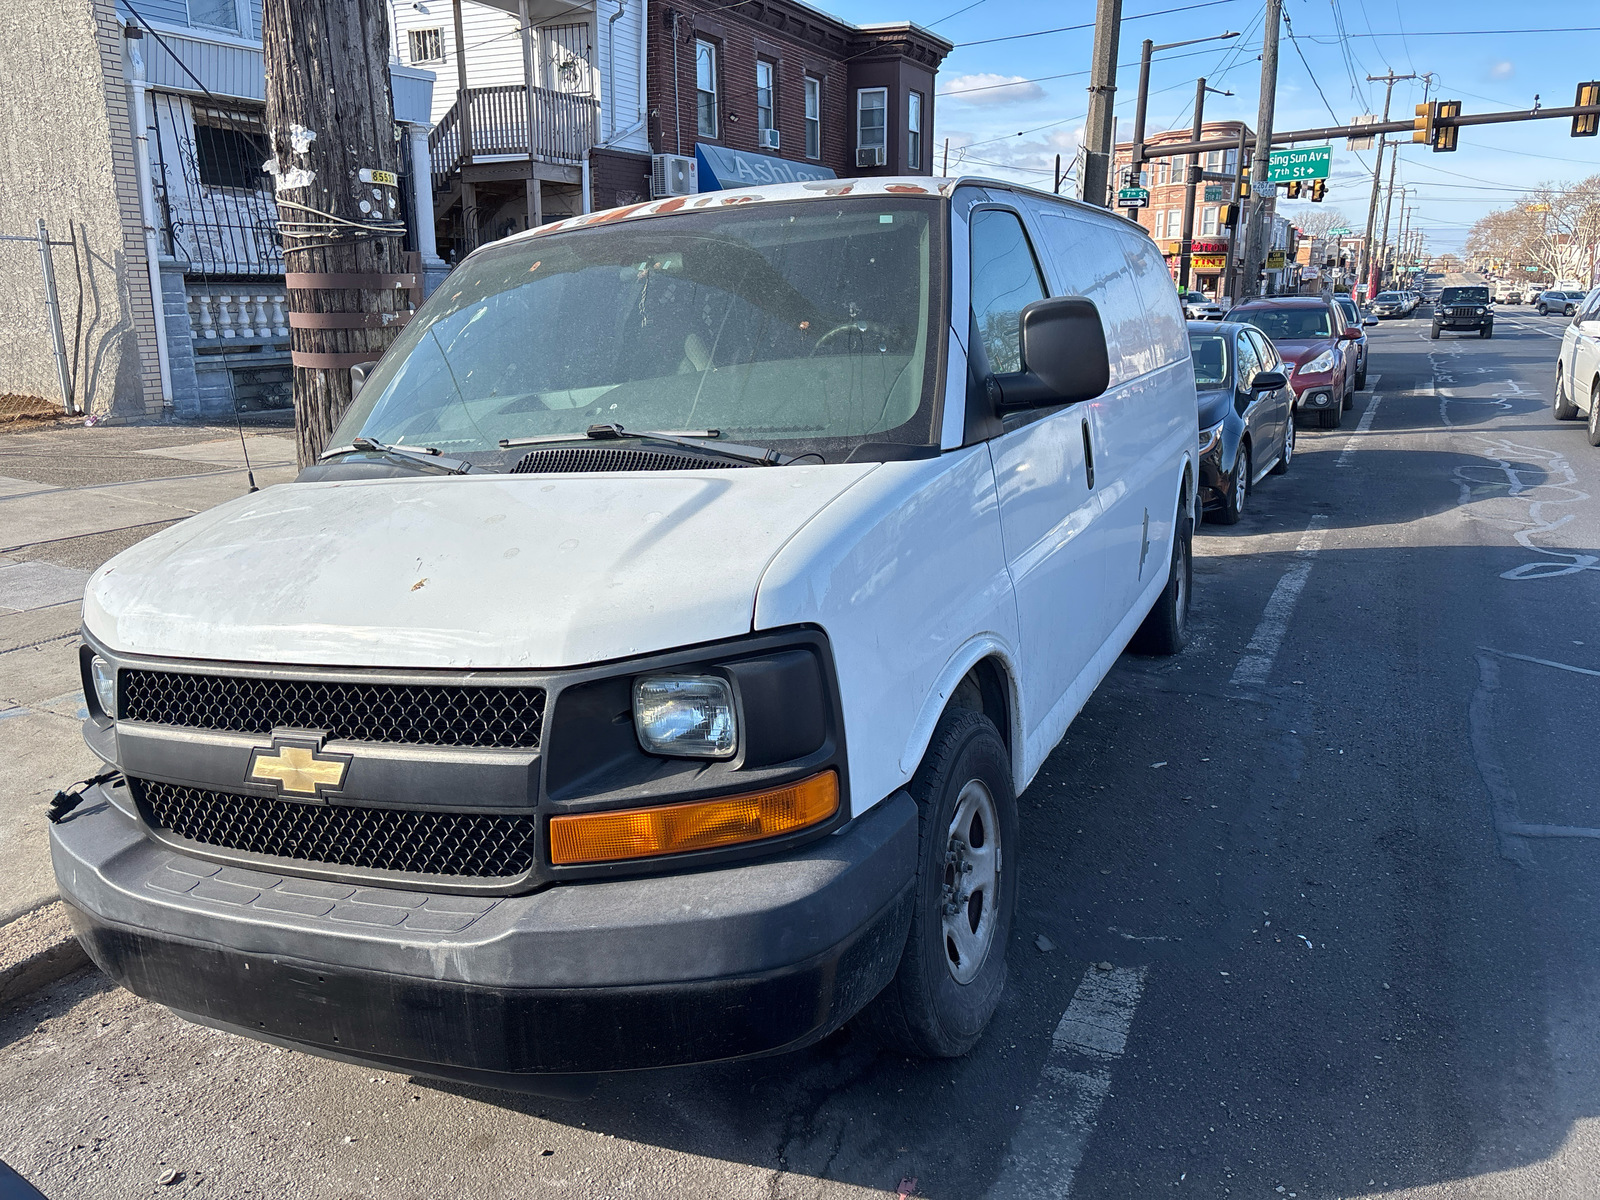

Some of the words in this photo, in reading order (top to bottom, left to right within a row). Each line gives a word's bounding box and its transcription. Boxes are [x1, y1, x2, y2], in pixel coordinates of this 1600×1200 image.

[1269, 154, 1288, 166] sing
[1290, 152, 1307, 164] Sun
[1309, 152, 1322, 162] Av
[1274, 168, 1290, 178] 7th
[1293, 166, 1305, 176] St
